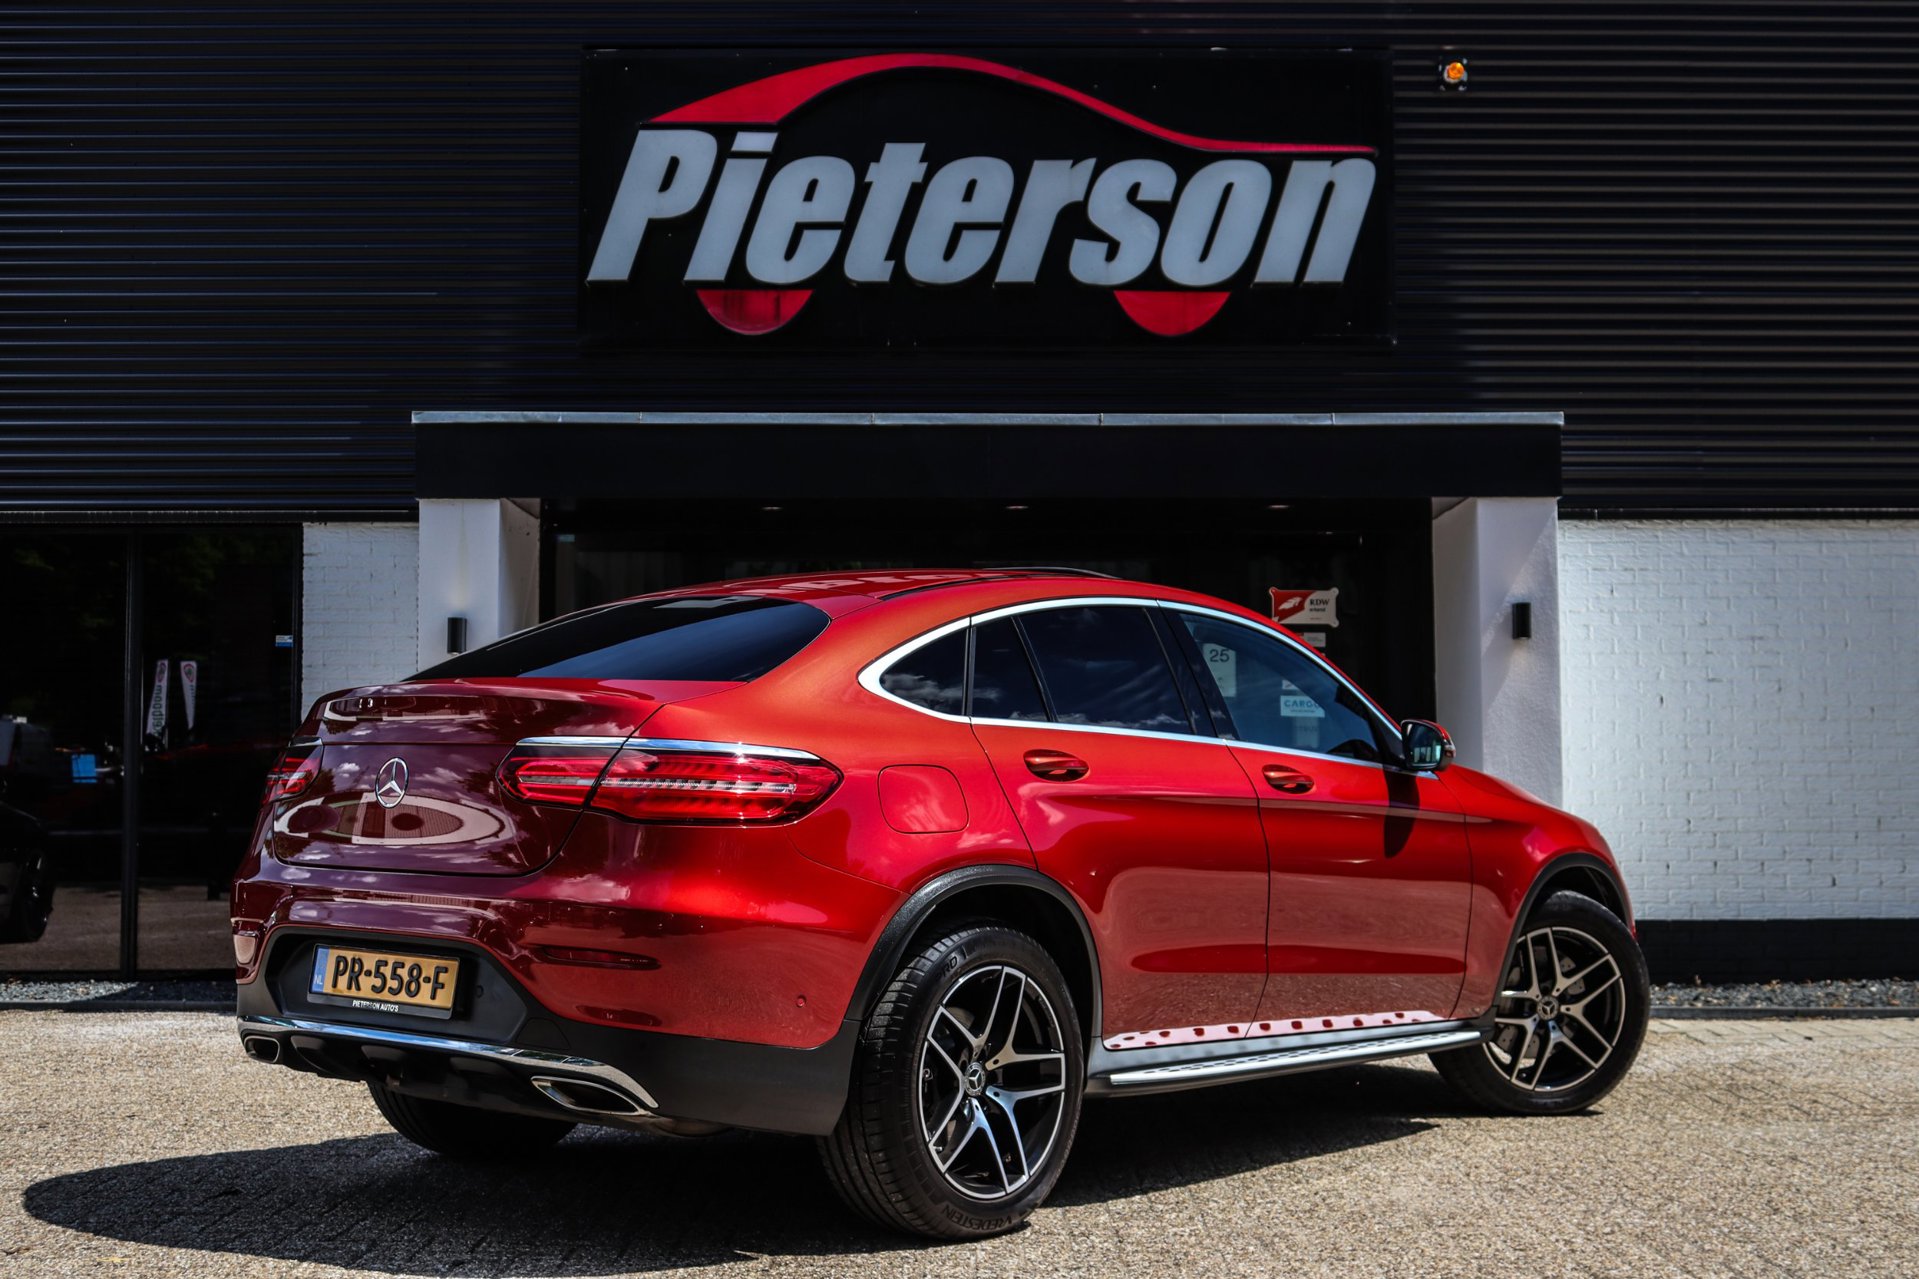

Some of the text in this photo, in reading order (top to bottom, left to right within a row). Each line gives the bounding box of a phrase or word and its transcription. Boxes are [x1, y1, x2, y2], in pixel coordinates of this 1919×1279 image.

[586, 128, 1379, 287] Pieterson
[1309, 598, 1331, 606] RDW
[1209, 648, 1230, 663] 25
[331, 955, 449, 1000] PR-558-F
[352, 999, 399, 1013] PIETERSON AUTO'S
